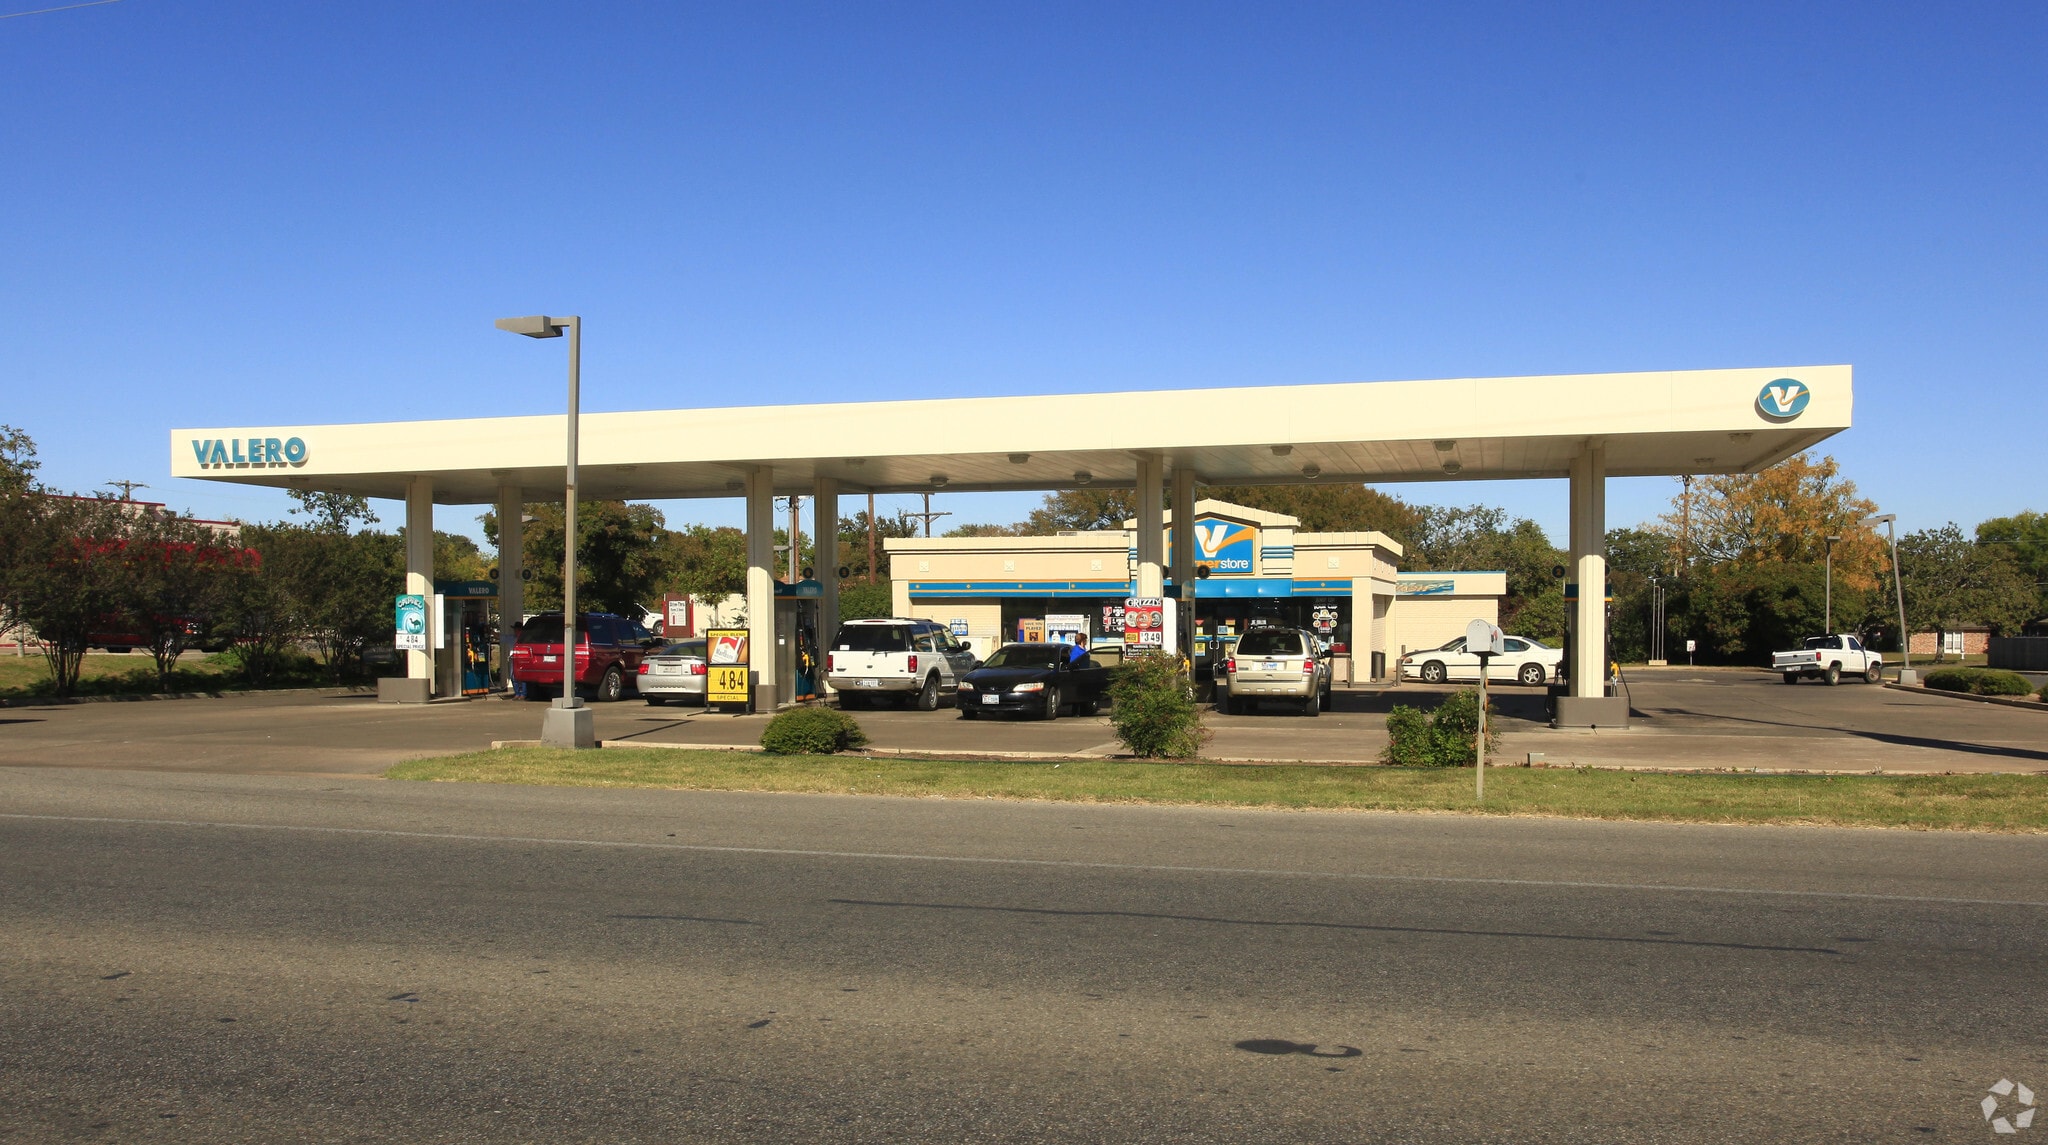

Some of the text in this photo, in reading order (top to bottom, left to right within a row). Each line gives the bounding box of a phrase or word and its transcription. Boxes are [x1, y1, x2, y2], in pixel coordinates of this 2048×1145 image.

[191, 437, 307, 465] VALERO
[468, 586, 490, 595] VALERO
[1126, 598, 1162, 609] GRIZZLY
